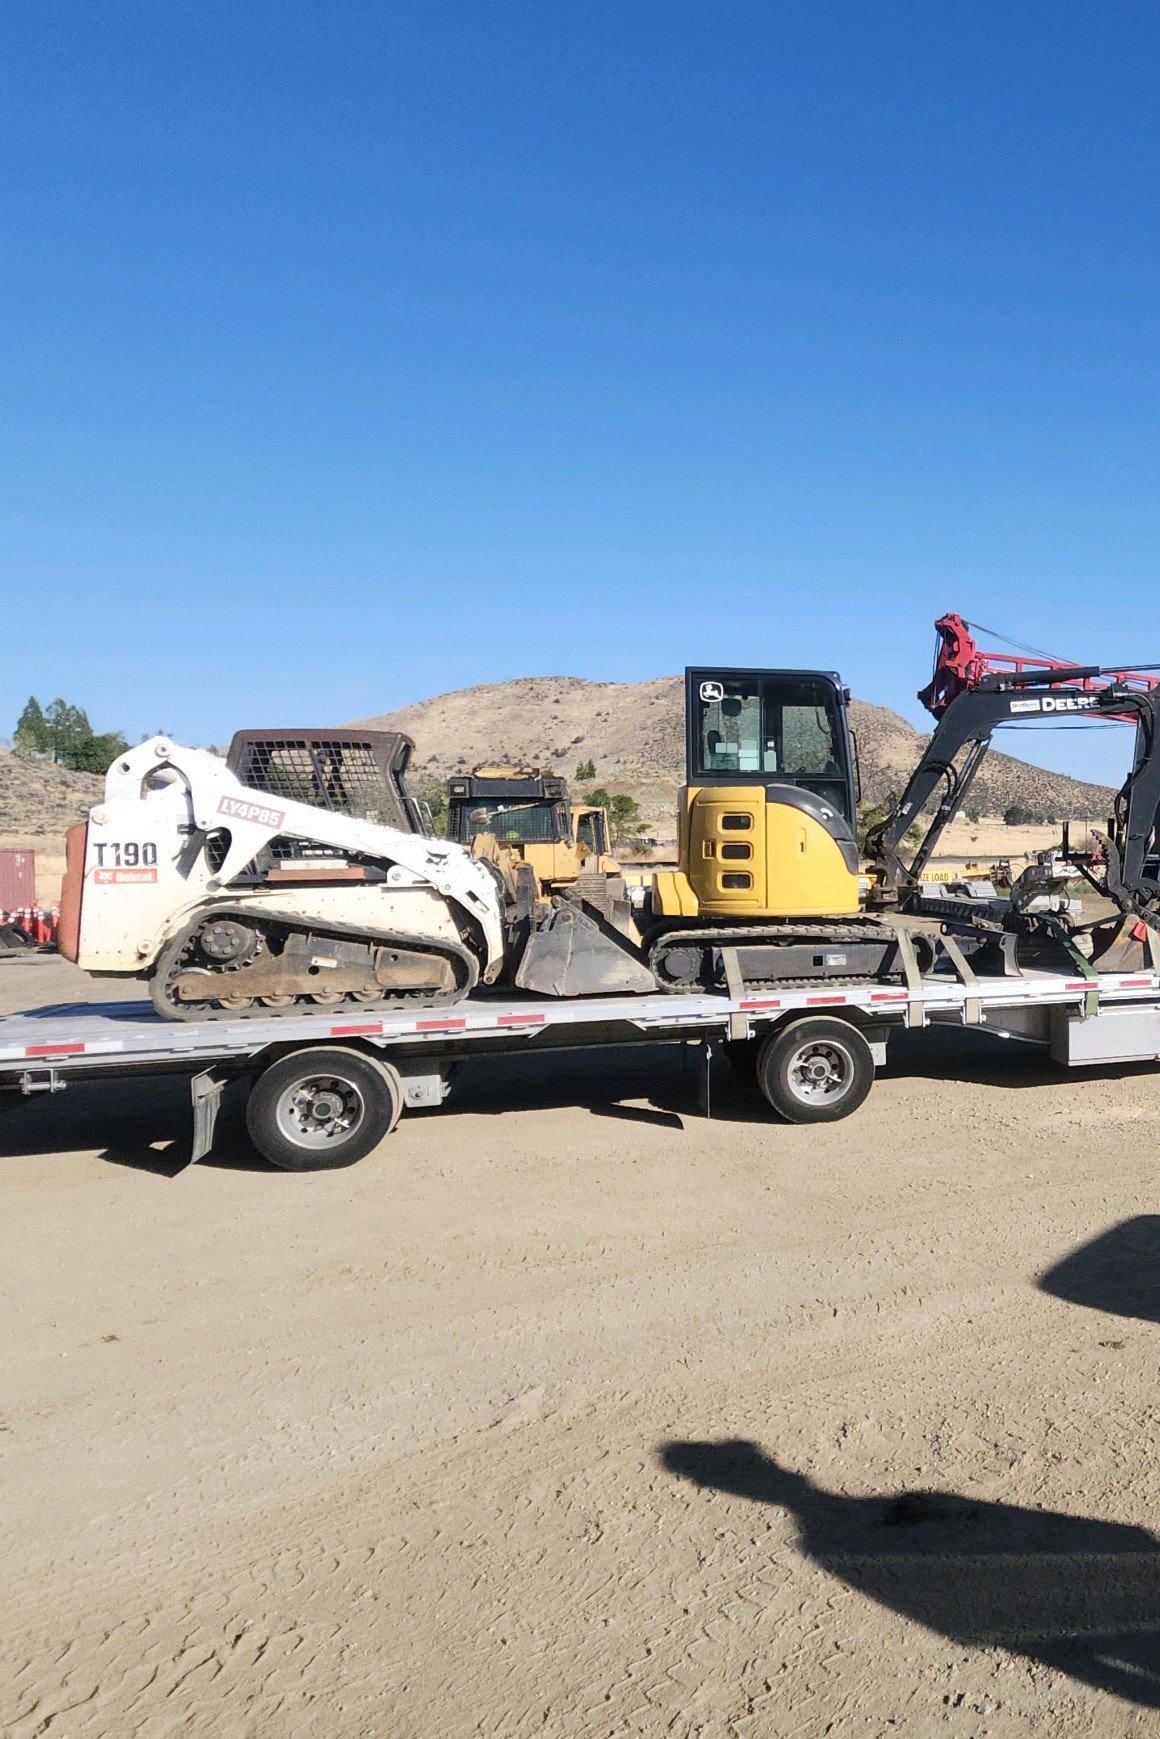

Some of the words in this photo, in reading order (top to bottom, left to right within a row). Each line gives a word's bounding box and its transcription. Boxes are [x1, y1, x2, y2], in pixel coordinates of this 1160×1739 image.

[1042, 696, 1100, 712] DEERE
[220, 798, 280, 826] LY4P85
[93, 842, 158, 867] T190
[931, 873, 949, 882] LOAD
